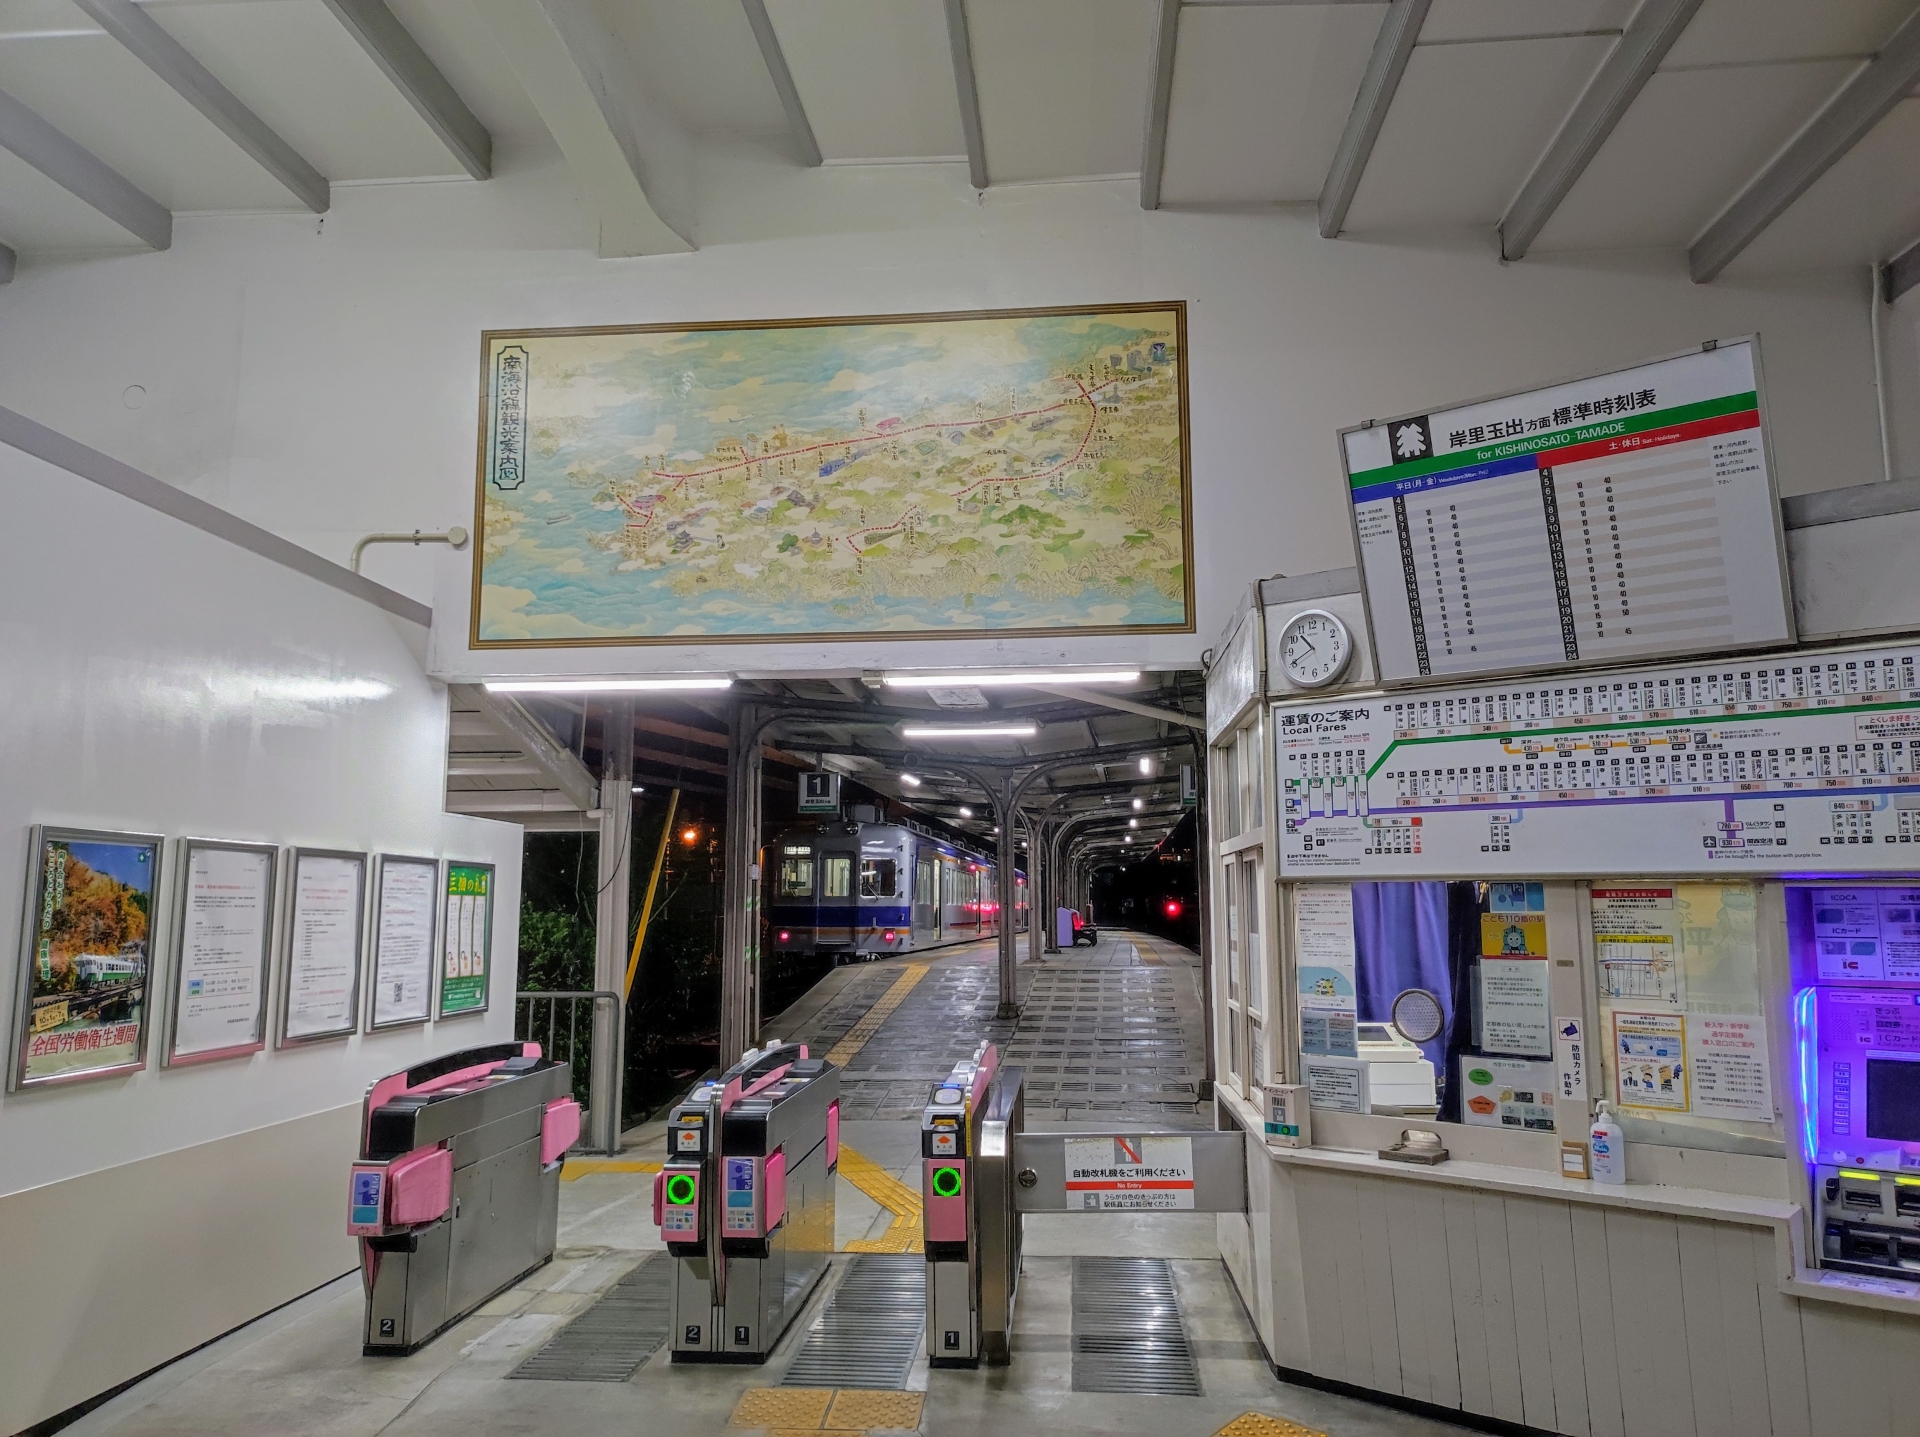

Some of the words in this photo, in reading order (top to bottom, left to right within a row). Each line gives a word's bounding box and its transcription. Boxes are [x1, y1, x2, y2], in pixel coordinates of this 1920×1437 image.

[500, 354, 523, 482] 南海沿線観光案内図
[1476, 449, 1493, 460] for
[1495, 421, 1626, 457] KISHINOSATO-TAMADE
[1542, 468, 1548, 477] 4
[1544, 477, 1550, 486] 5
[1545, 486, 1551, 495] 6
[1604, 476, 1611, 484] 40
[1546, 496, 1553, 504] 7
[1548, 505, 1554, 513] 8
[1549, 514, 1555, 523] 9
[1580, 509, 1586, 517] 10
[1548, 523, 1559, 532] 10
[1550, 532, 1560, 541] 11
[1551, 542, 1561, 550] 12
[1584, 537, 1590, 545] 10
[1612, 533, 1619, 541] 40
[1552, 551, 1563, 559] 13
[1554, 560, 1564, 569] 14
[1555, 569, 1565, 578] 15
[1588, 565, 1594, 573] 10
[1616, 561, 1622, 569] 40
[1556, 578, 1567, 587] 16
[1558, 588, 1568, 596] 17
[1559, 597, 1569, 605] 18
[1592, 593, 1598, 601] 10
[1560, 606, 1571, 615] 19
[1562, 615, 1572, 624] 20
[1595, 612, 1601, 620] 15
[1622, 608, 1629, 616] 50
[1298, 625, 1305, 634] 11
[1308, 620, 1317, 630] 12
[1322, 622, 1326, 631] 1
[1563, 624, 1573, 633] 21
[1596, 621, 1602, 629] 30
[1330, 629, 1336, 638] 2
[1564, 634, 1575, 642] 22
[1598, 630, 1603, 638] 10
[1625, 627, 1632, 635] 45
[1289, 635, 1298, 644] 10
[1333, 641, 1339, 650] 3
[1566, 643, 1576, 651] 23
[1288, 648, 1294, 656] 9
[1567, 652, 1578, 661] 24
[1331, 653, 1337, 663] 4
[1300, 666, 1306, 676] 7
[1312, 668, 1318, 677] 6
[1323, 663, 1329, 672] 5
[1850, 671, 1858, 692] 高野下
[1869, 670, 1877, 690] 下古沢
[1887, 668, 1896, 689] 上古沢
[1281, 708, 1370, 727] 運賃のご案内
[1283, 725, 1312, 735] Local
[1316, 723, 1347, 732] Fares
[813, 777, 821, 794] 1
[1482, 914, 1545, 923] こども110番の駅
[1875, 1007, 1900, 1015] きっぷ
[1711, 1031, 1744, 1039] 通学定期券
[28, 1024, 138, 1058] 全国労働衛生週間
[1702, 1039, 1756, 1048] 購入窓口のご案内
[1571, 1044, 1582, 1085] 防犯カメラ
[1563, 1072, 1573, 1097] 作動中
[1072, 1168, 1186, 1179] 自動改札機をご利用ください
[382, 1320, 392, 1331] 2
[687, 1326, 698, 1338] 2
[738, 1327, 746, 1338] 1
[948, 1331, 955, 1343] 1
